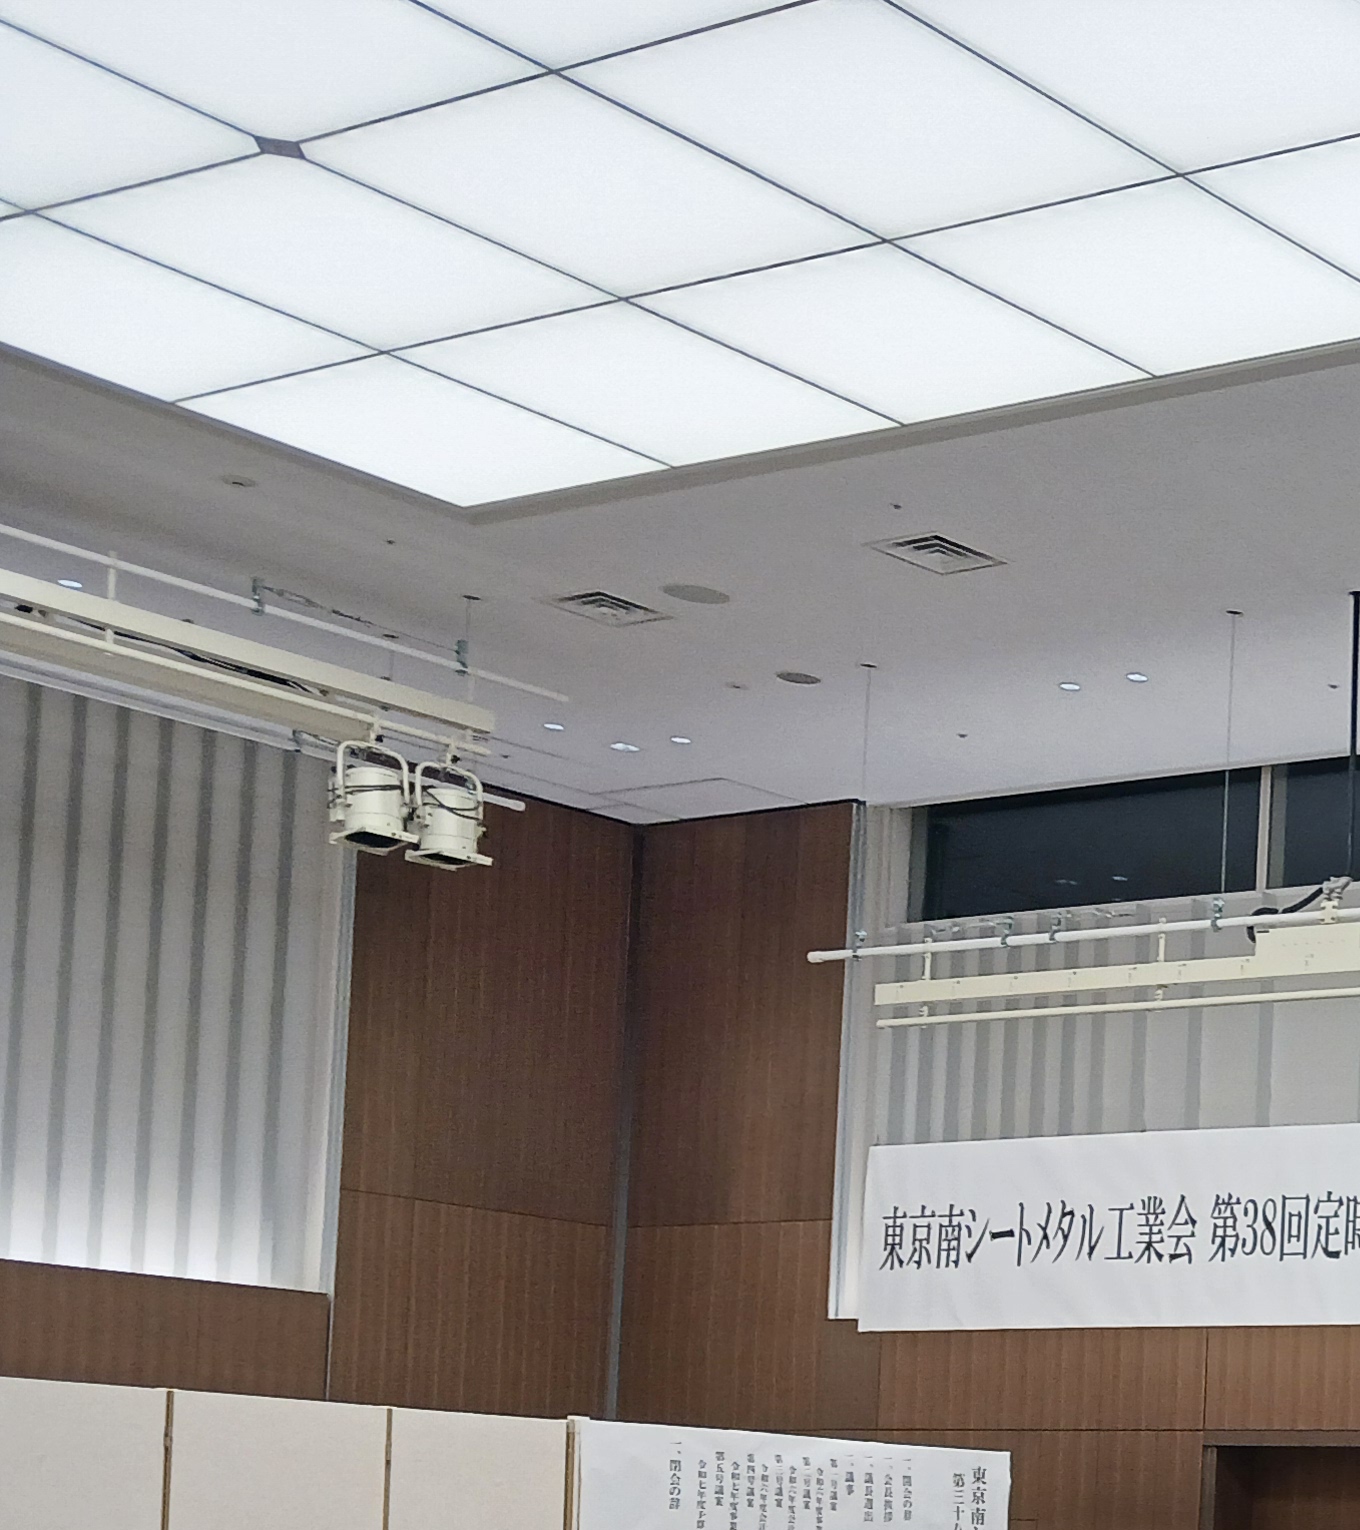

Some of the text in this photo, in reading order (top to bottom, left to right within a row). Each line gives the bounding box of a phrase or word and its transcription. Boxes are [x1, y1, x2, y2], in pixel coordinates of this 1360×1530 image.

[878, 1194, 1198, 1271] 東京南シートメタル工業会
